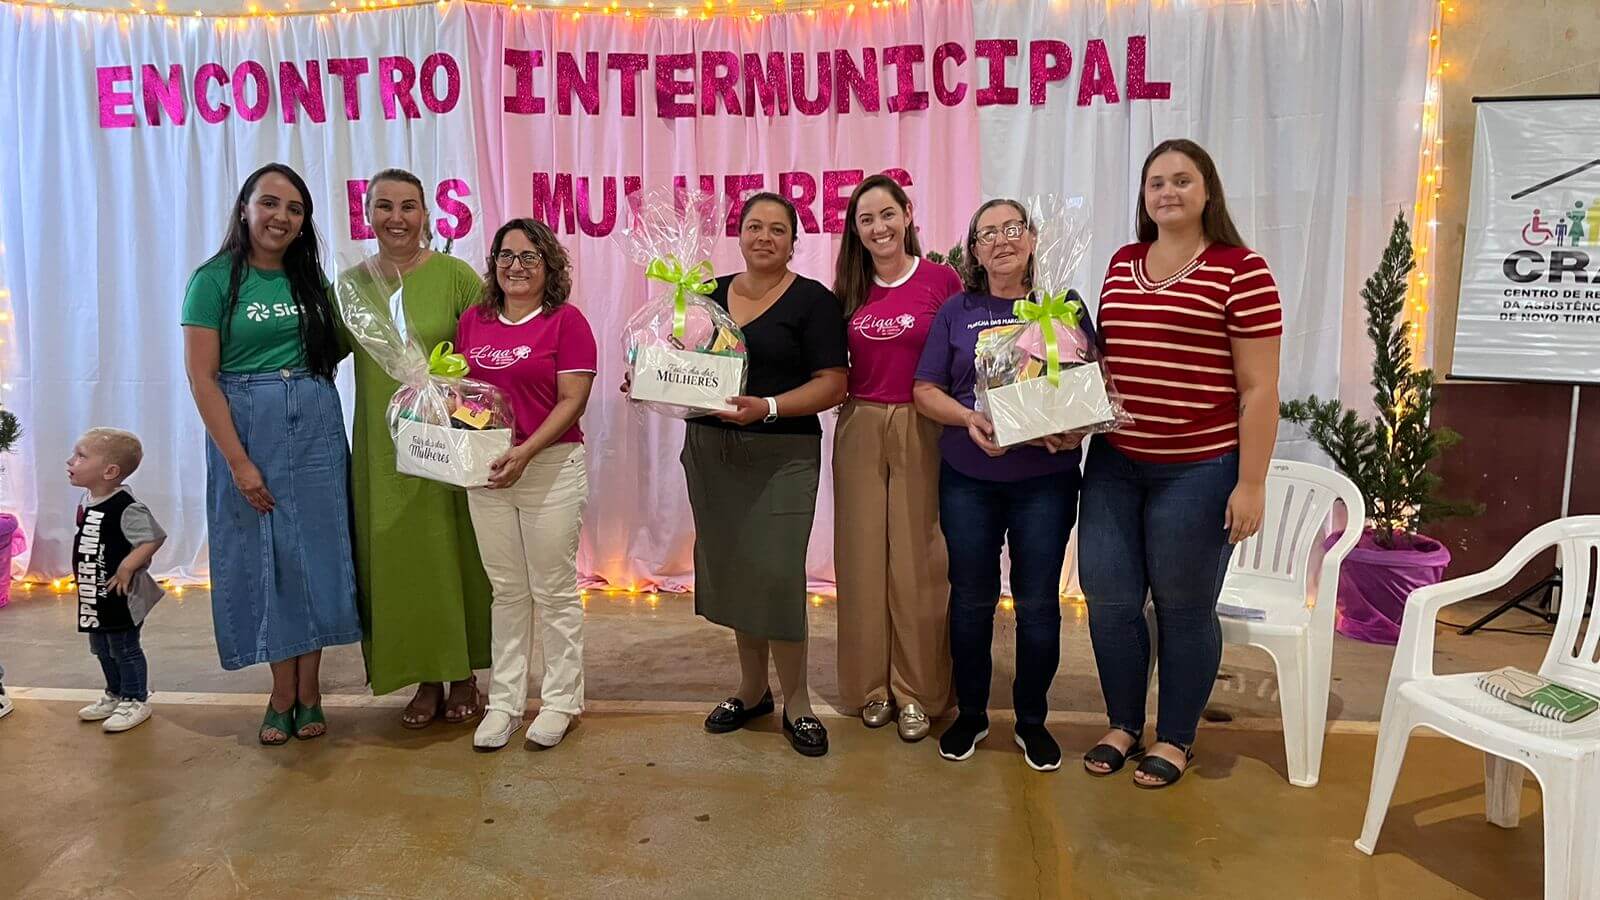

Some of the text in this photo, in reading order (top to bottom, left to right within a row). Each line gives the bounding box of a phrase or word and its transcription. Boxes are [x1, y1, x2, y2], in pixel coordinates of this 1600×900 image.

[97, 35, 1171, 128] ENCONTRO INTERMUNICIPAL
[347, 179, 472, 240] DS
[1503, 288, 1559, 298] CENTRO
[1562, 289, 1581, 299] DE
[1503, 300, 1520, 310] DA
[853, 314, 898, 333] Liga
[967, 321, 990, 329] MARCHA
[1500, 312, 1517, 321] DE
[1521, 312, 1559, 322] NOVO
[470, 345, 512, 362] Liga
[656, 369, 719, 388] MULHERES
[408, 443, 450, 464] Mulheres
[78, 509, 105, 628] SPIDER-MAN
